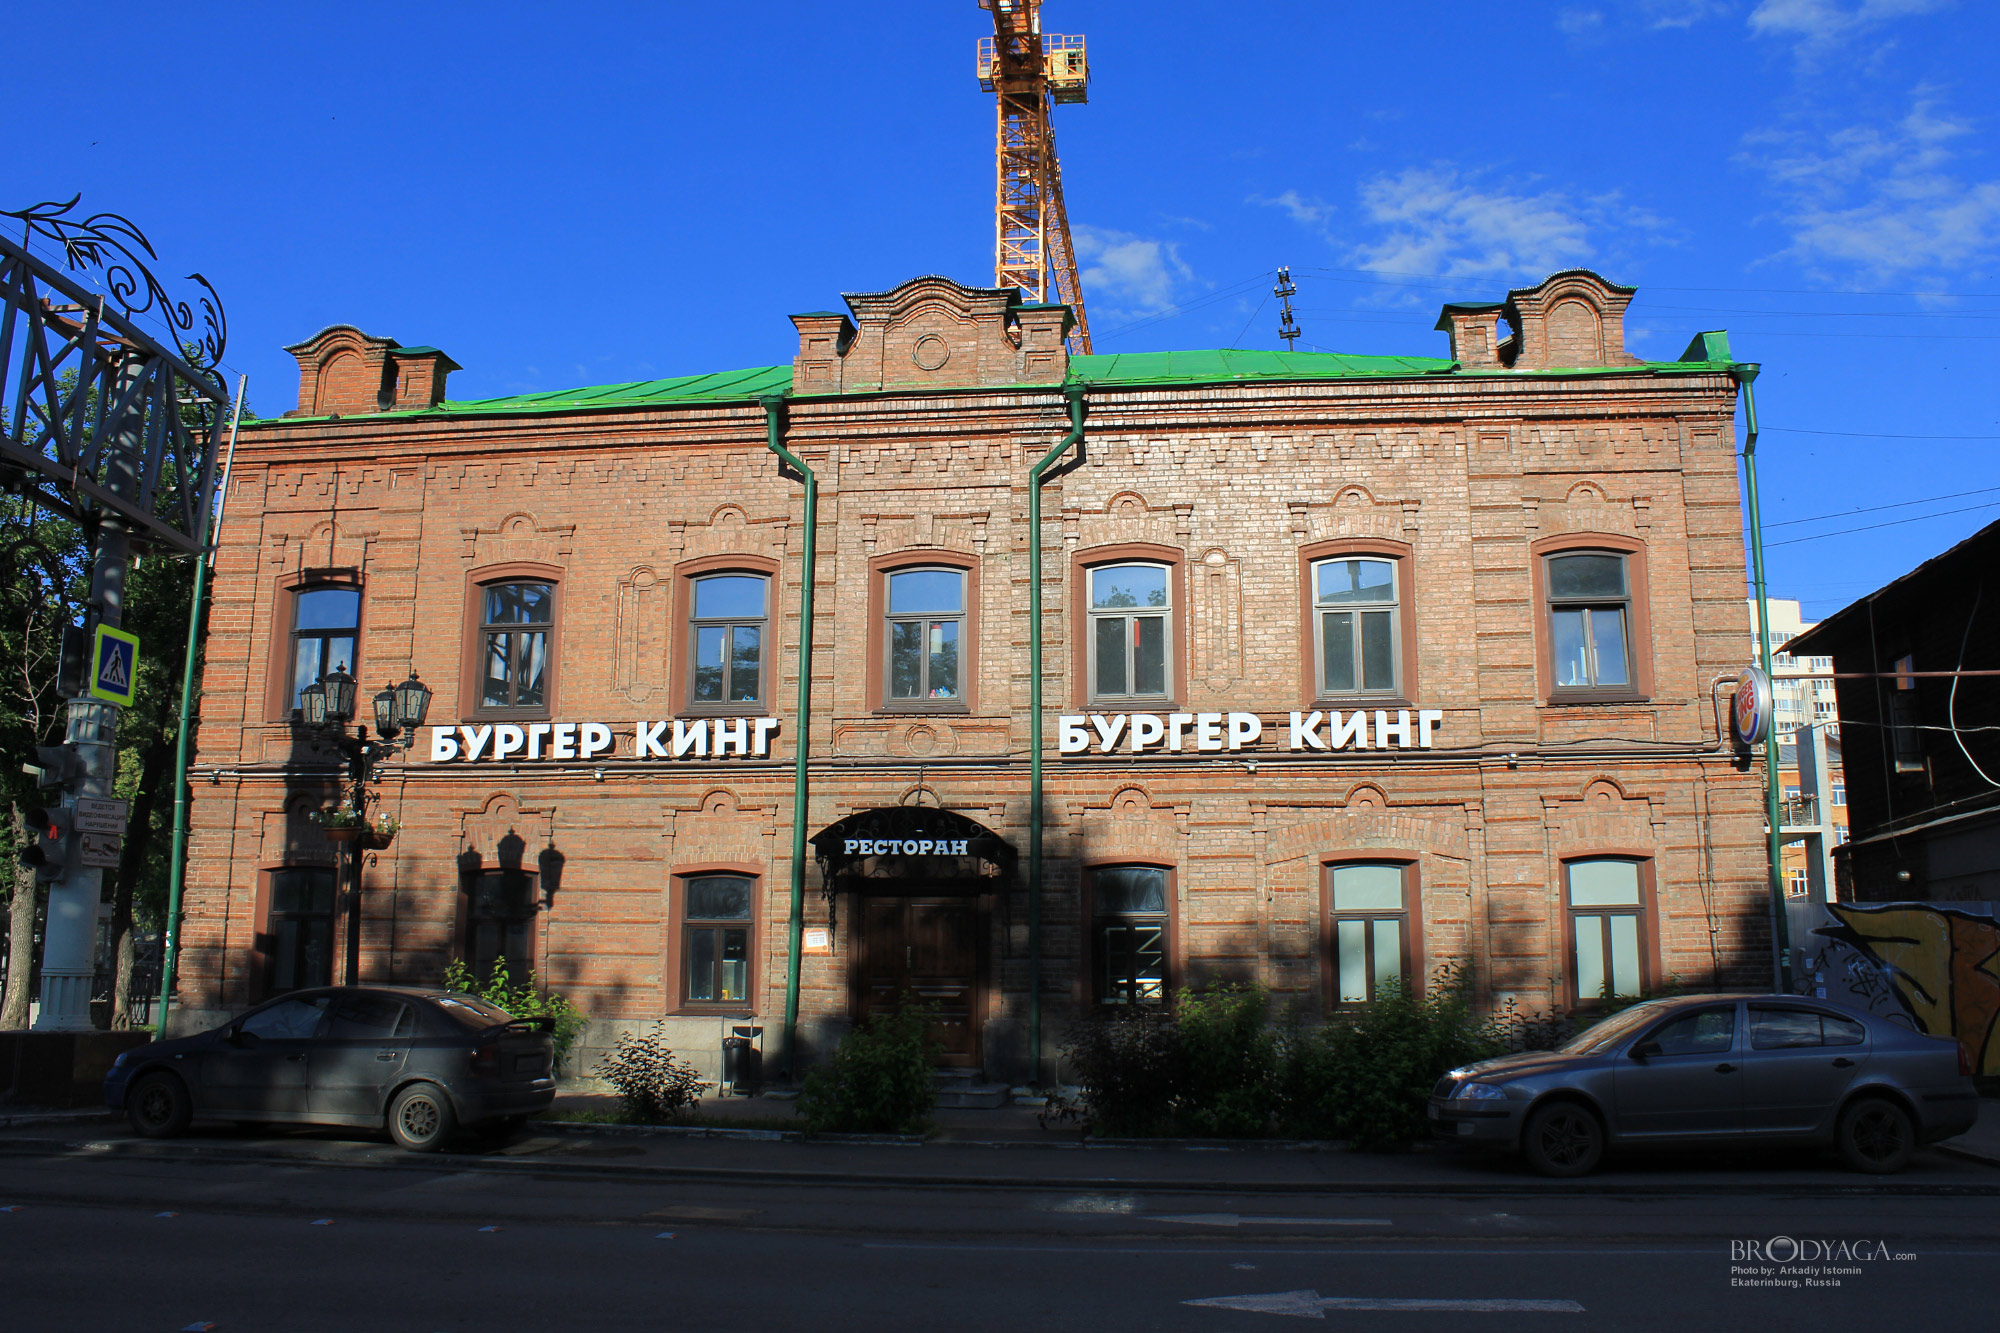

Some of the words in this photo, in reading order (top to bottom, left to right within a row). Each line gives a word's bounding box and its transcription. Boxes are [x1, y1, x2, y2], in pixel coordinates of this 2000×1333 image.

[430, 722, 613, 761] БУРГЕР
[635, 718, 778, 757] КИНГ
[1058, 712, 1262, 753] БУРГЕР
[1289, 709, 1443, 749] КИНГ
[843, 839, 968, 856] РЕСТОРАН
